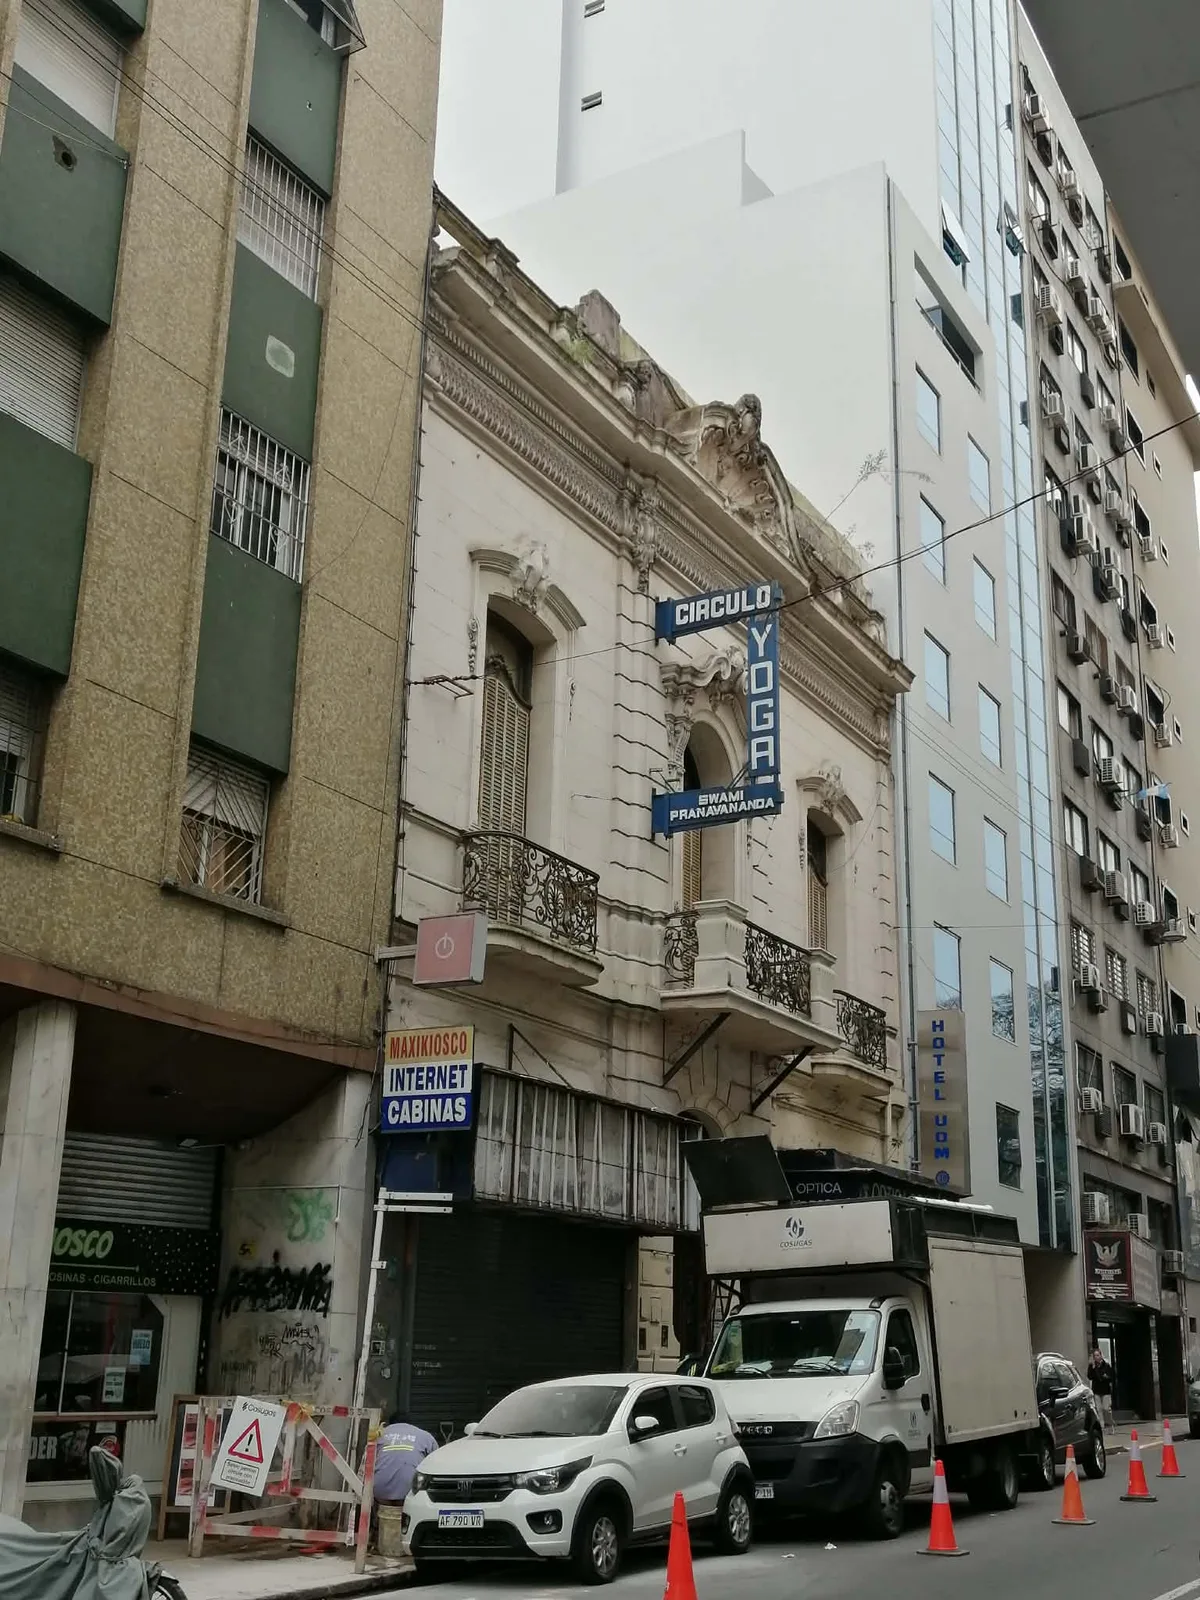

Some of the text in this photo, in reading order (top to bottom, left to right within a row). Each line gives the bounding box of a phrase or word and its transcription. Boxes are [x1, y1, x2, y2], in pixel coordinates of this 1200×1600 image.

[675, 585, 771, 626] CIRCULO
[750, 624, 774, 770] YOGA
[670, 797, 774, 822] PRANAVANANDA
[698, 789, 744, 806] SWAMI
[390, 1030, 467, 1059] MAXIKIOSCO
[390, 1064, 468, 1092] INTERNET
[931, 1020, 949, 1159] HOTEL UOM
[387, 1096, 466, 1124] CABINAS
[796, 1181, 842, 1194] OPTICA
[780, 1238, 813, 1248] COSUGAS
[93, 1274, 157, 1287] CIGARRILLOS
[440, 1515, 481, 1526] AF 790 VR
